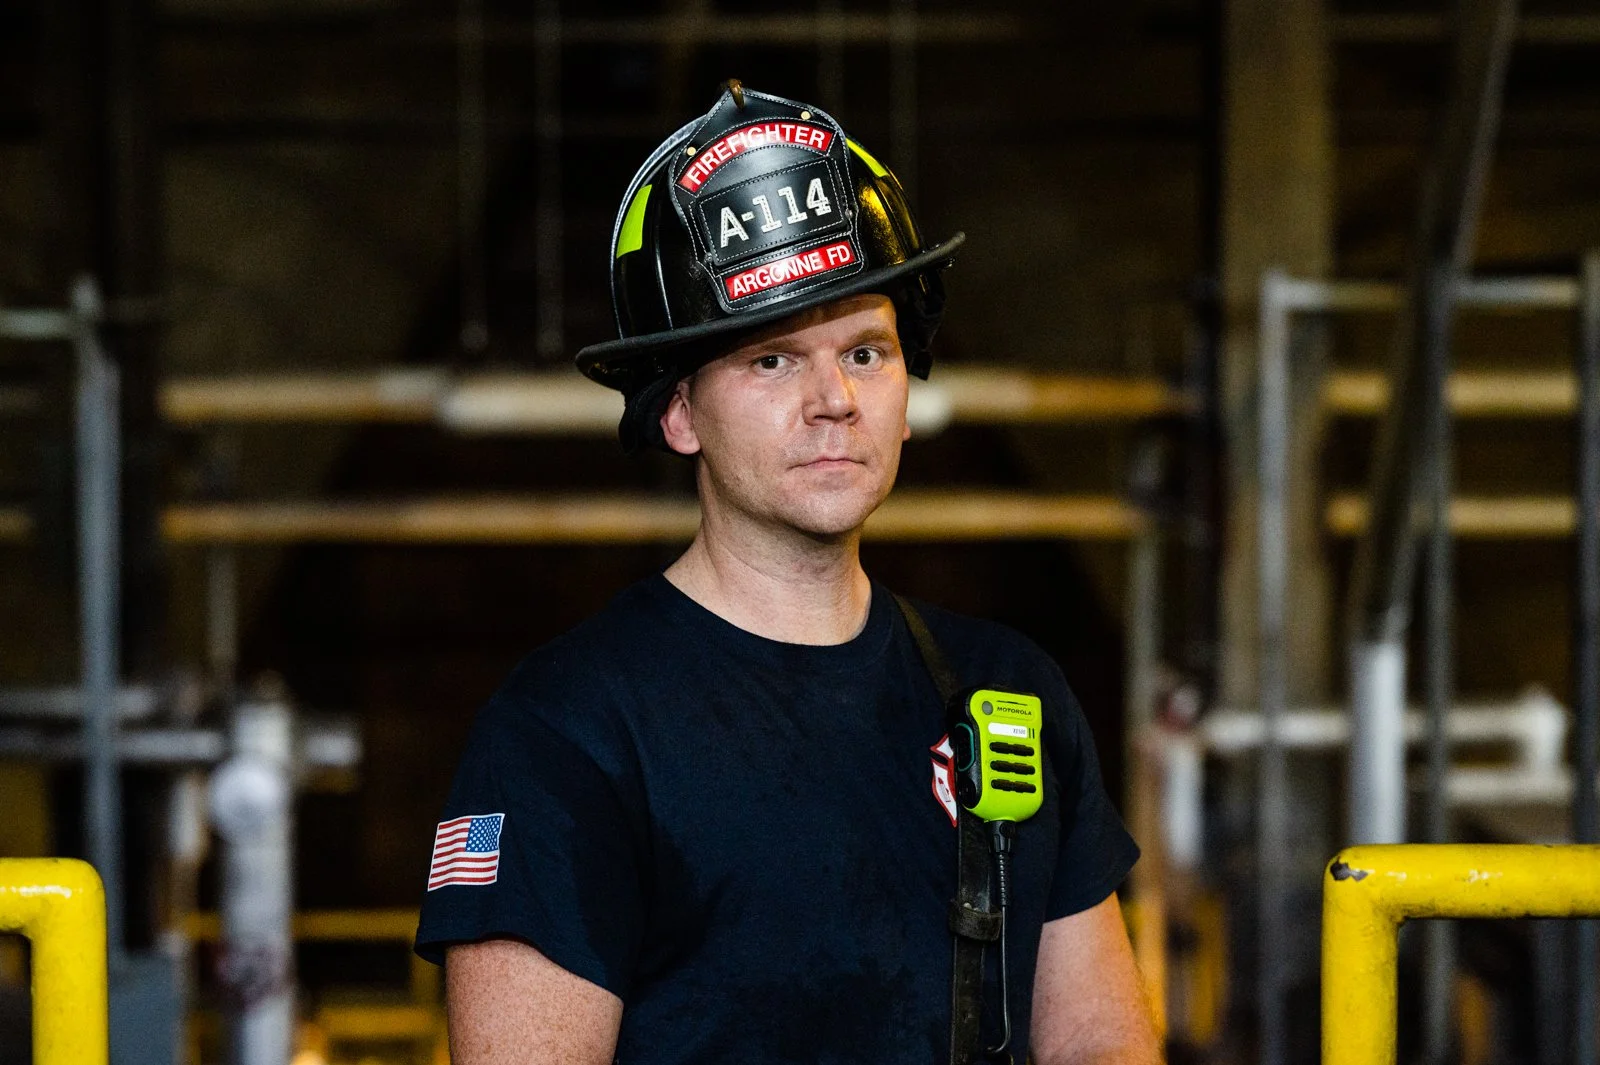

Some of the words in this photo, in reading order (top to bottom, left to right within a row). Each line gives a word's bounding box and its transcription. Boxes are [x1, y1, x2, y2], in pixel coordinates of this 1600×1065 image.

[686, 124, 826, 186] FIREFIGHTER
[720, 177, 832, 248] A-114
[733, 252, 823, 297] ARGONNE
[828, 244, 851, 266] FD
[997, 706, 1032, 716] MOTOROLA
